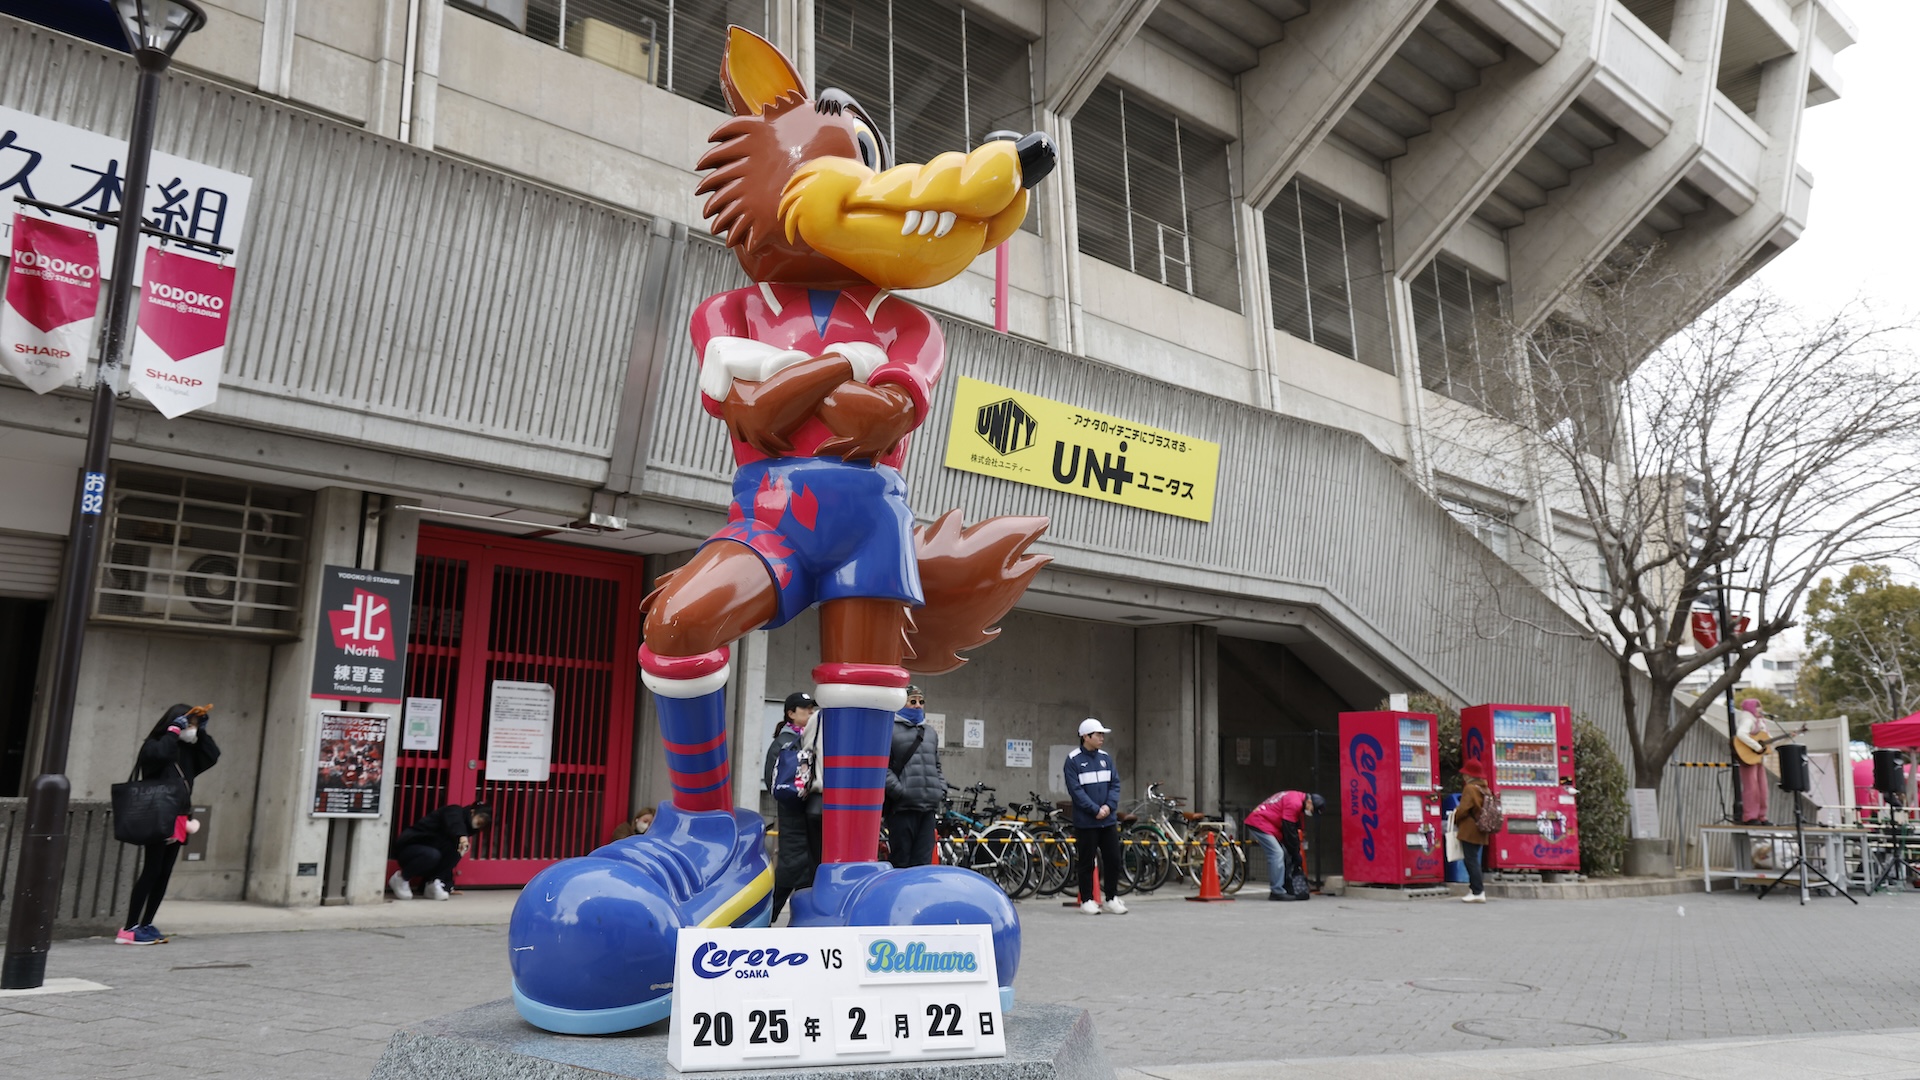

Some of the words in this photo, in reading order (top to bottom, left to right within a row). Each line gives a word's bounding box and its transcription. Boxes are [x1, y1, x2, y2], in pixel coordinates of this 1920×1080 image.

[14, 249, 94, 279] YODOKO
[14, 266, 41, 277] SAKURA
[55, 274, 91, 288] STADIUM
[148, 280, 224, 310] YODOKO
[148, 296, 176, 309] SAKURA
[187, 306, 221, 319] STADIUM
[15, 343, 70, 359] SHARP
[146, 368, 203, 387] SHARP
[977, 400, 1036, 454] UNITY
[970, 453, 1031, 473] 株式会社ユニティー
[85, 474, 105, 493] お
[1137, 471, 1195, 500] ユニタス
[82, 494, 103, 513] 32
[372, 576, 400, 585] STADIUM
[340, 594, 387, 641] 北
[344, 643, 380, 658] North
[333, 664, 385, 684] 練習室
[333, 682, 361, 694] Training
[362, 685, 383, 693] Room
[1349, 733, 1383, 862] Cerezo
[1350, 778, 1359, 816] OSAKA
[691, 941, 809, 979] Cerezo
[820, 948, 843, 970] VS
[866, 938, 978, 974] Bellmare
[734, 969, 770, 979] OSAKA
